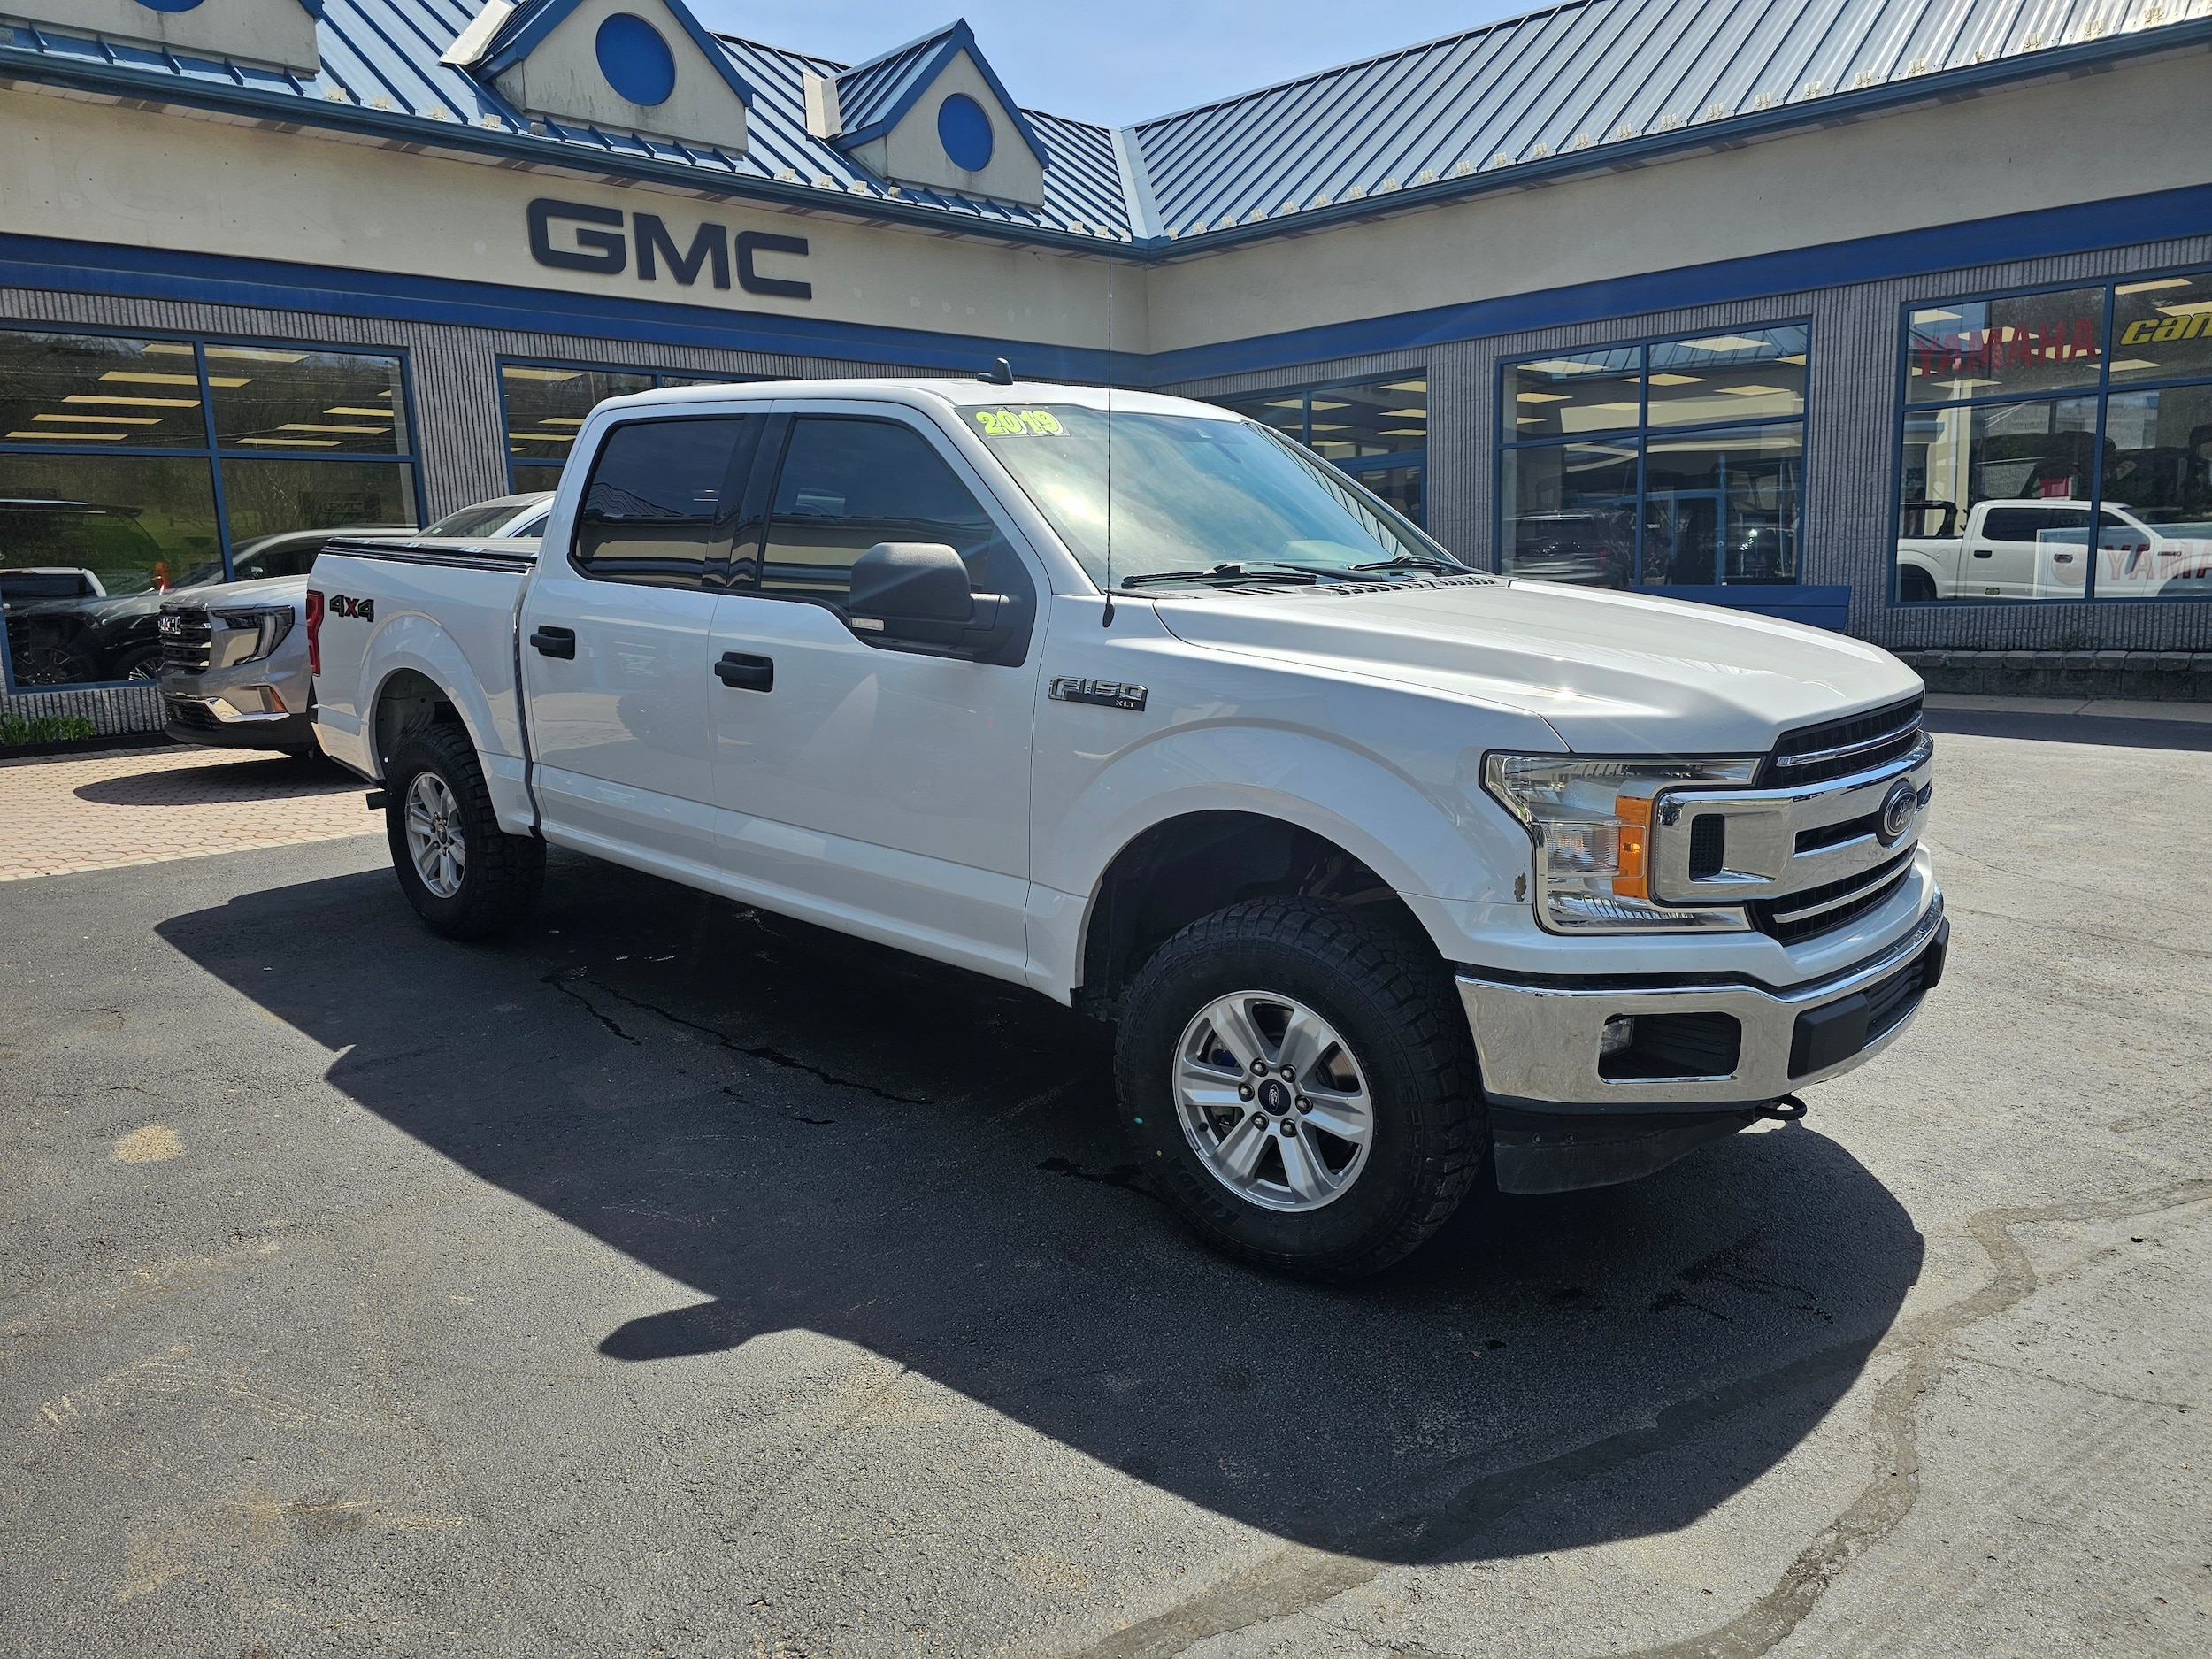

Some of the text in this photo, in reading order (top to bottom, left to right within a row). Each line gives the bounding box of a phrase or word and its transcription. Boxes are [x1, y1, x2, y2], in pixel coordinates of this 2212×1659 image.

[526, 197, 812, 300] GMC
[2118, 311, 2212, 346] can
[1914, 317, 2098, 378] YAMAHA
[976, 410, 1064, 435] 2019
[1115, 699, 1136, 709] XLT
[1893, 796, 1915, 827] Ford
